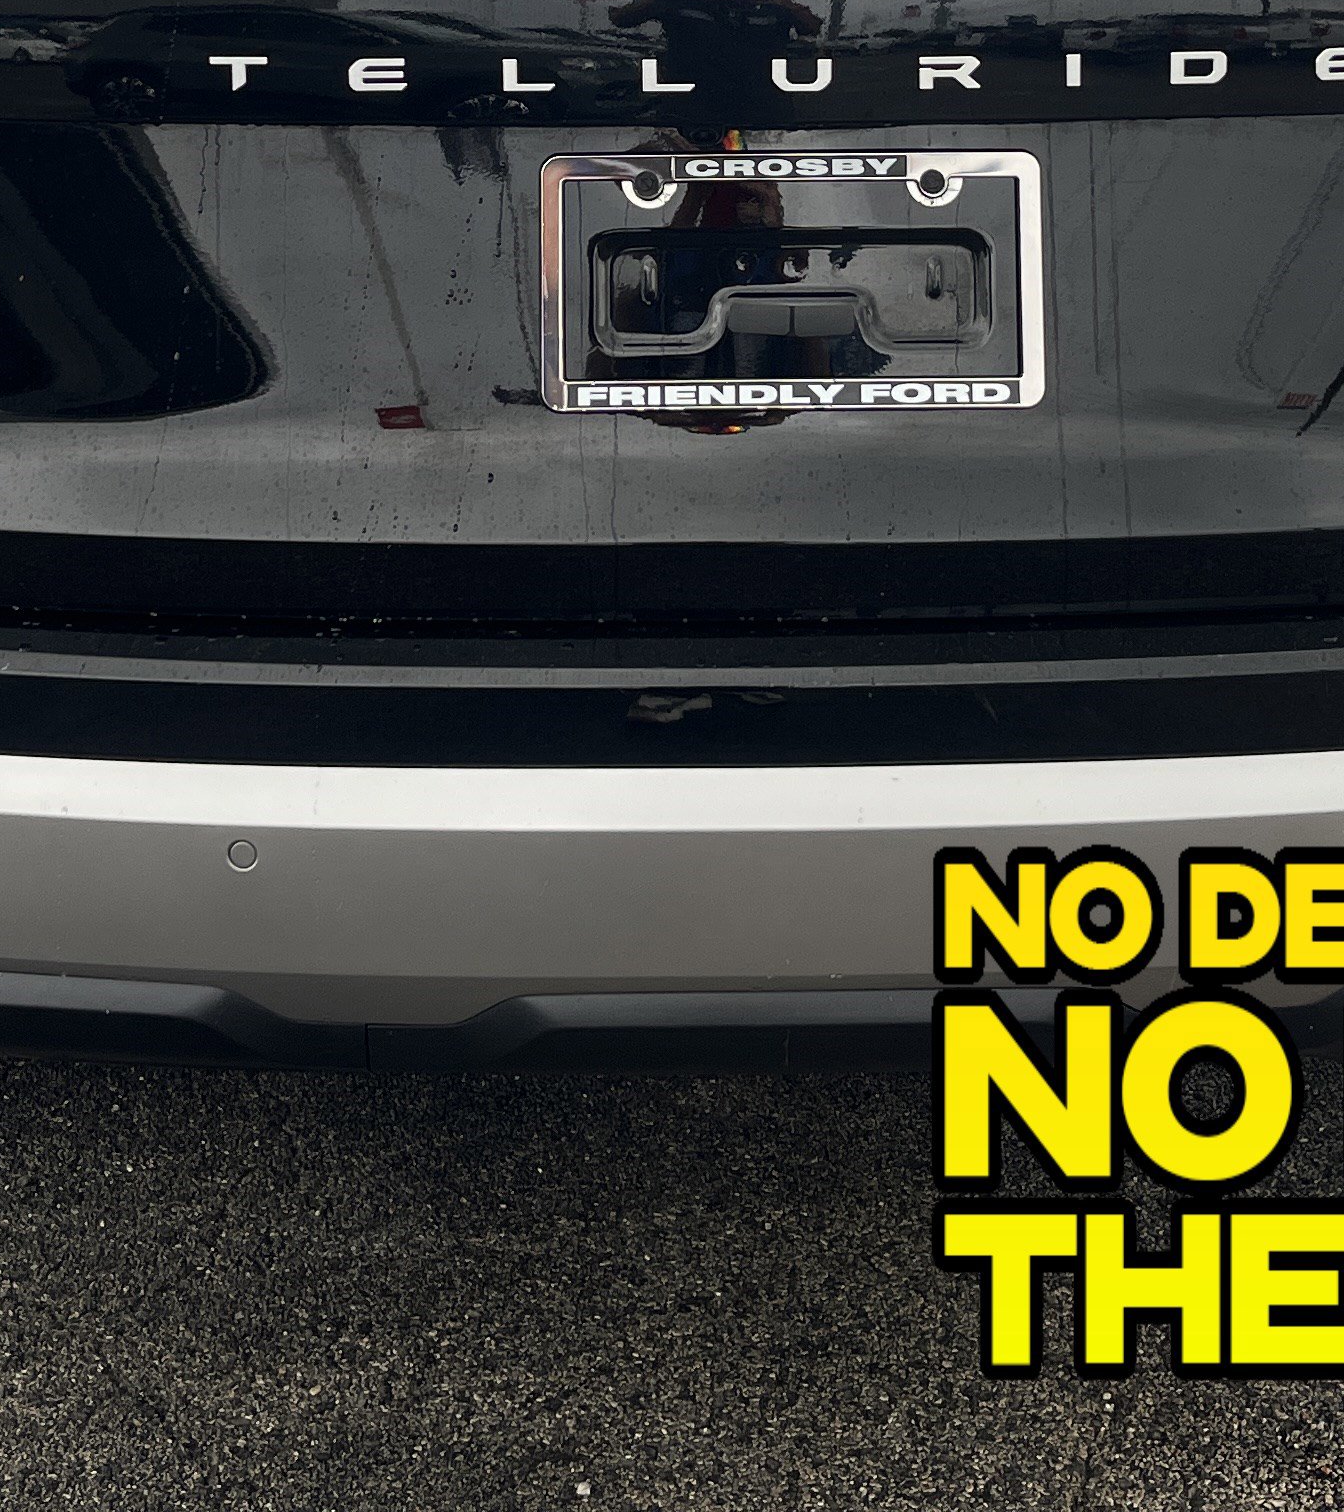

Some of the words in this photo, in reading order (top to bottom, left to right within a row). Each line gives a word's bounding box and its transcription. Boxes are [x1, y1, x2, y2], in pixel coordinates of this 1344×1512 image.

[684, 157, 898, 177] CROSBY
[577, 383, 845, 407] FRIENDLY
[860, 382, 1011, 404] FORD
